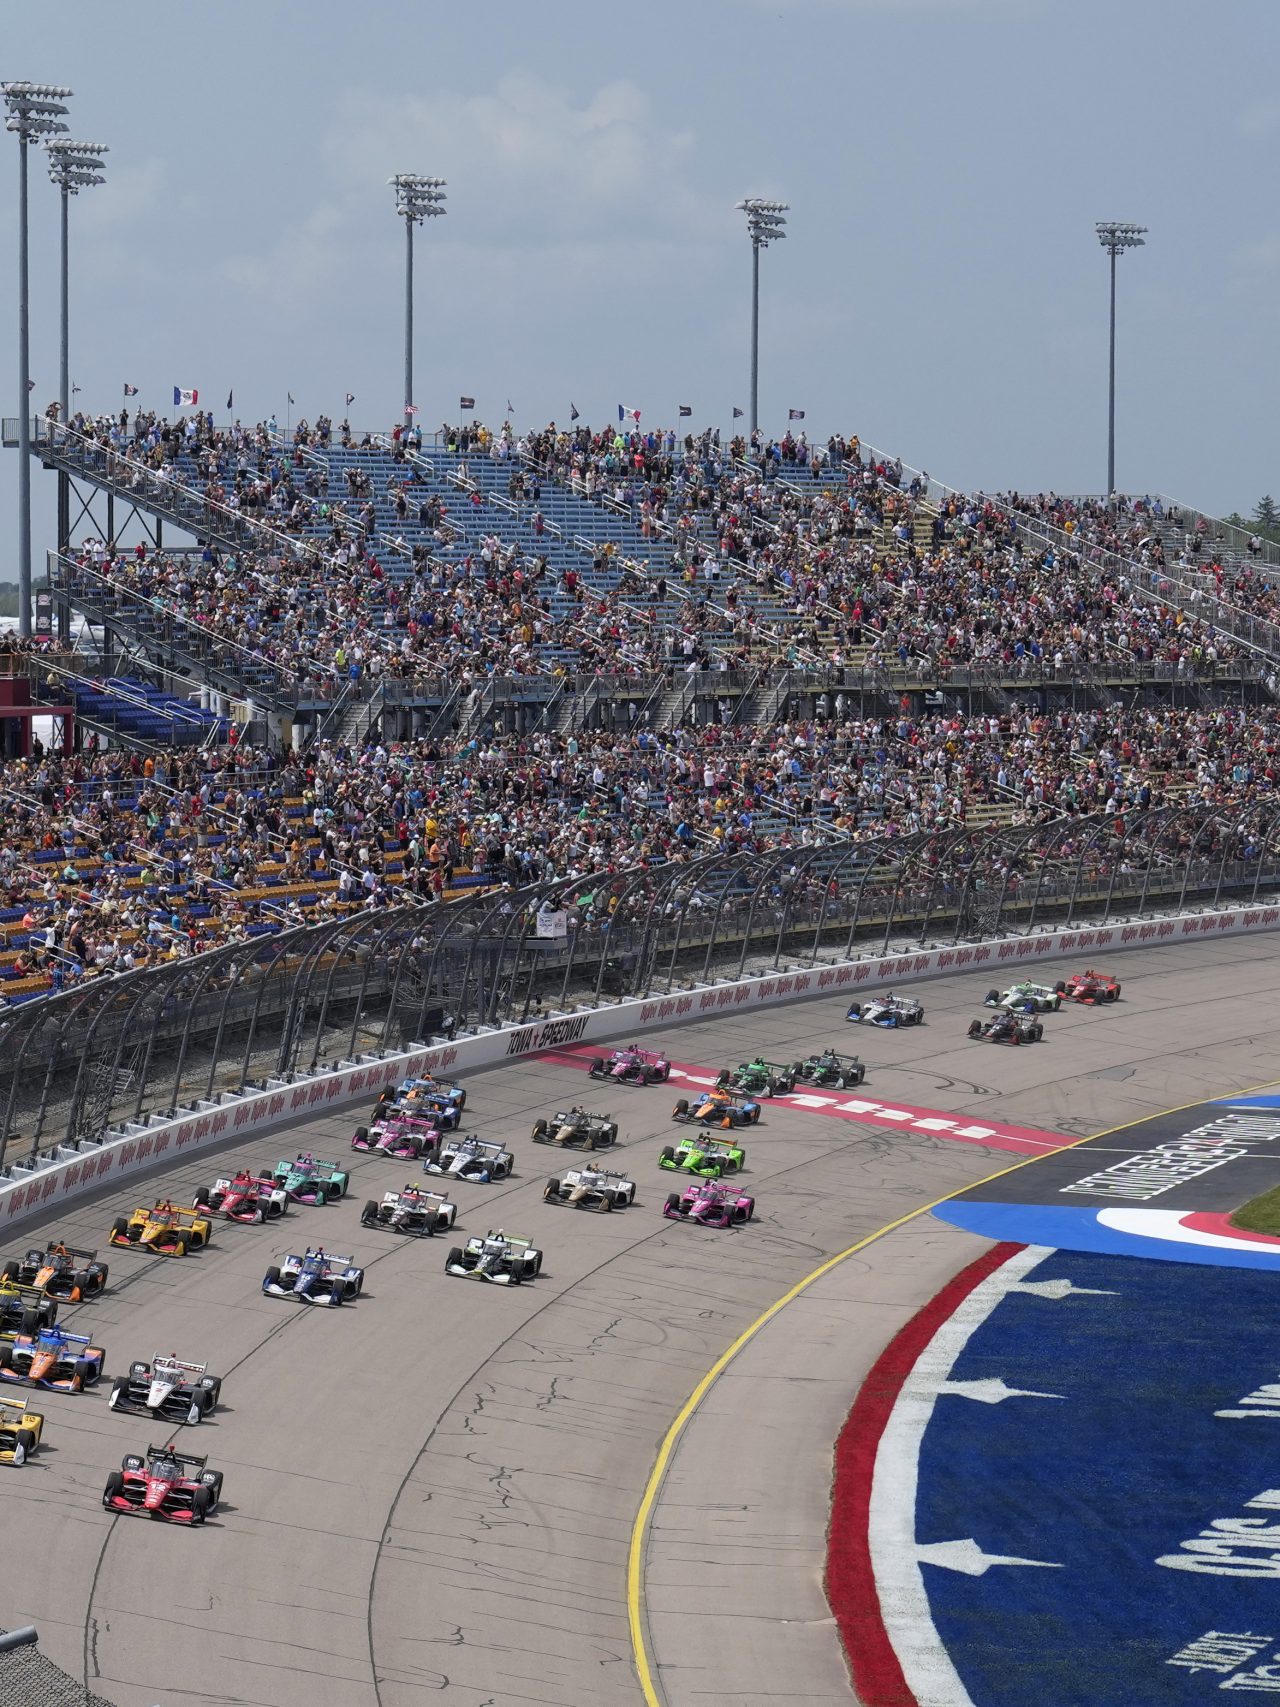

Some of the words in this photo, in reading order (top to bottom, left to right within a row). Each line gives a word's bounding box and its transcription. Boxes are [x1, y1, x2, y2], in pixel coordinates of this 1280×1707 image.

[506, 1028, 534, 1055] IOWA
[538, 1016, 590, 1048] SPEEDWAY
[151, 1483, 166, 1491] 12
